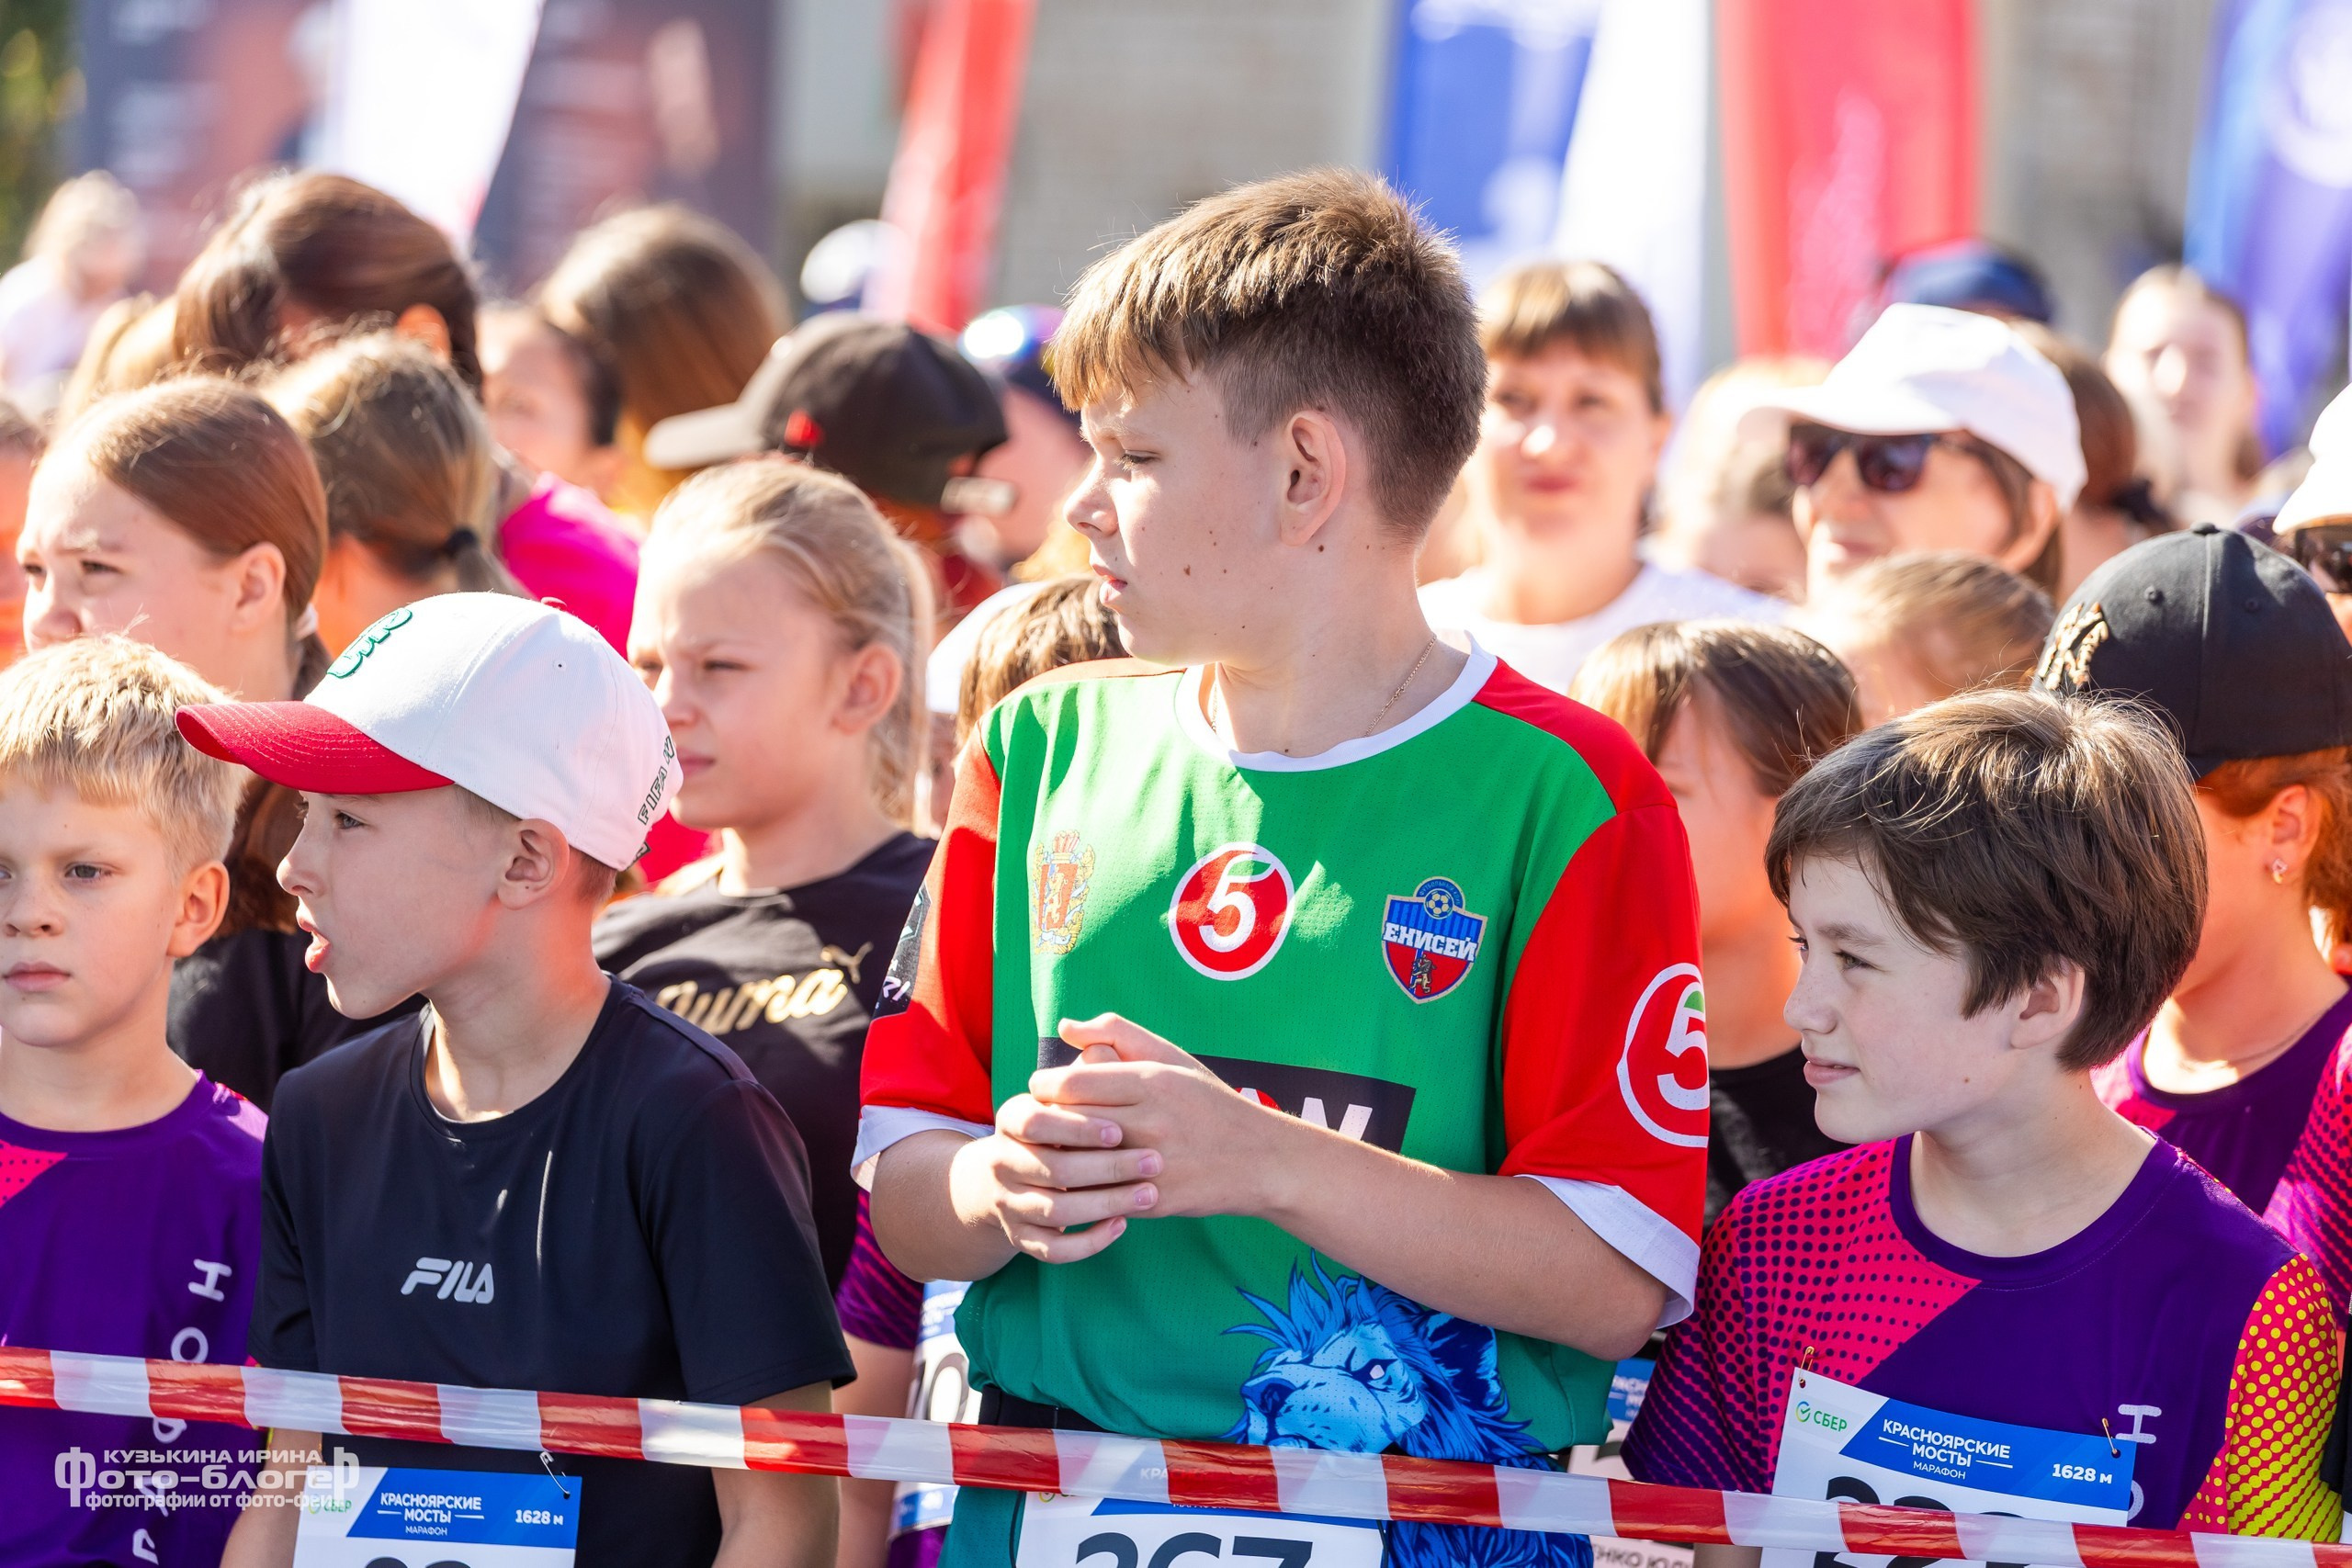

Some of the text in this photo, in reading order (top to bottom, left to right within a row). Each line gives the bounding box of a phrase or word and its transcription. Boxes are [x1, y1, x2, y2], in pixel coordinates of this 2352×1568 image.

[637, 765, 668, 826] FIFA
[1198, 852, 1274, 953] 5
[1383, 921, 1478, 962] ЕНИСЕЙ
[400, 1257, 495, 1304] FILA
[1813, 1410, 1849, 1432] СБЕР
[1883, 1418, 2011, 1460] КРАСНОЯРСКИЕ
[1912, 1443, 1972, 1468] МОСТЫ
[1913, 1461, 1966, 1481] МАРАФОН
[2052, 1463, 2097, 1483] 1628
[379, 1492, 482, 1511] КРАСНОЯРСКИЕ
[403, 1508, 452, 1524] МОСТЫ
[514, 1509, 551, 1525] 1628
[404, 1525, 448, 1537] МАРАФОН
